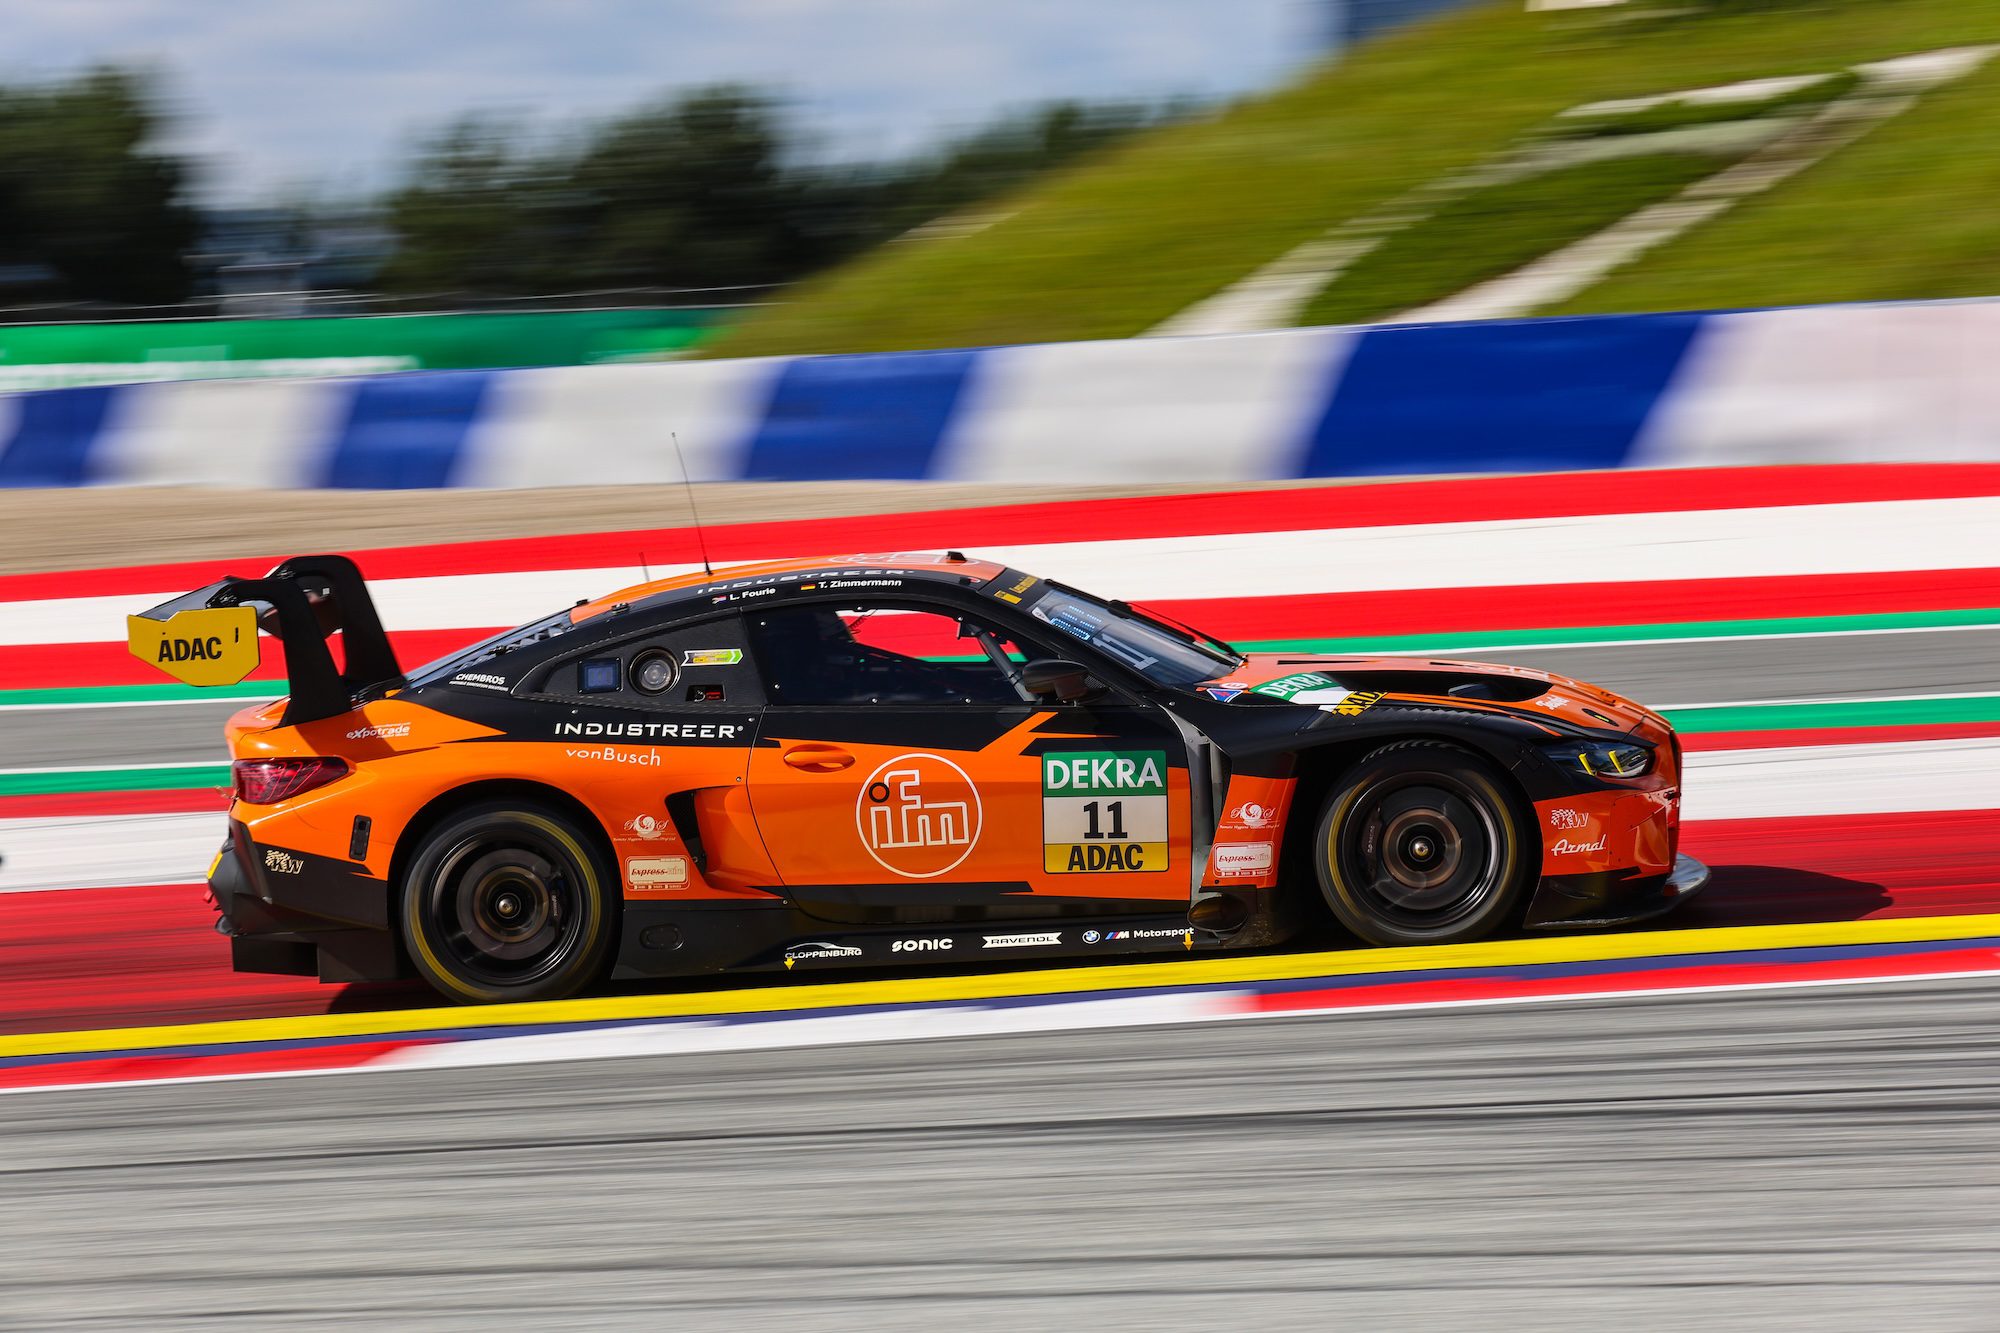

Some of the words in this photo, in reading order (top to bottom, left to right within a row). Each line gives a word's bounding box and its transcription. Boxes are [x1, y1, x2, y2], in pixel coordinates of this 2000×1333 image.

[729, 592, 740, 601] L.
[742, 587, 776, 599] Fourie
[818, 581, 828, 589] T.
[830, 579, 902, 589] Zimmermann
[158, 636, 222, 662] ADAC
[455, 673, 506, 685] CHEMBROS
[1257, 674, 1333, 697] DEKRA
[565, 747, 661, 767] vonBusch
[1046, 757, 1164, 790] DEKRA
[868, 769, 970, 849] ifm
[1082, 800, 1128, 839] 11
[1553, 810, 1589, 829] KW
[1551, 833, 1606, 857] Armal
[267, 852, 304, 874] KW
[1066, 843, 1144, 871] ADAC
[991, 936, 1054, 945] RAVENOL
[1133, 926, 1194, 939] Motorsport
[785, 949, 863, 959] CLOPPENBURG
